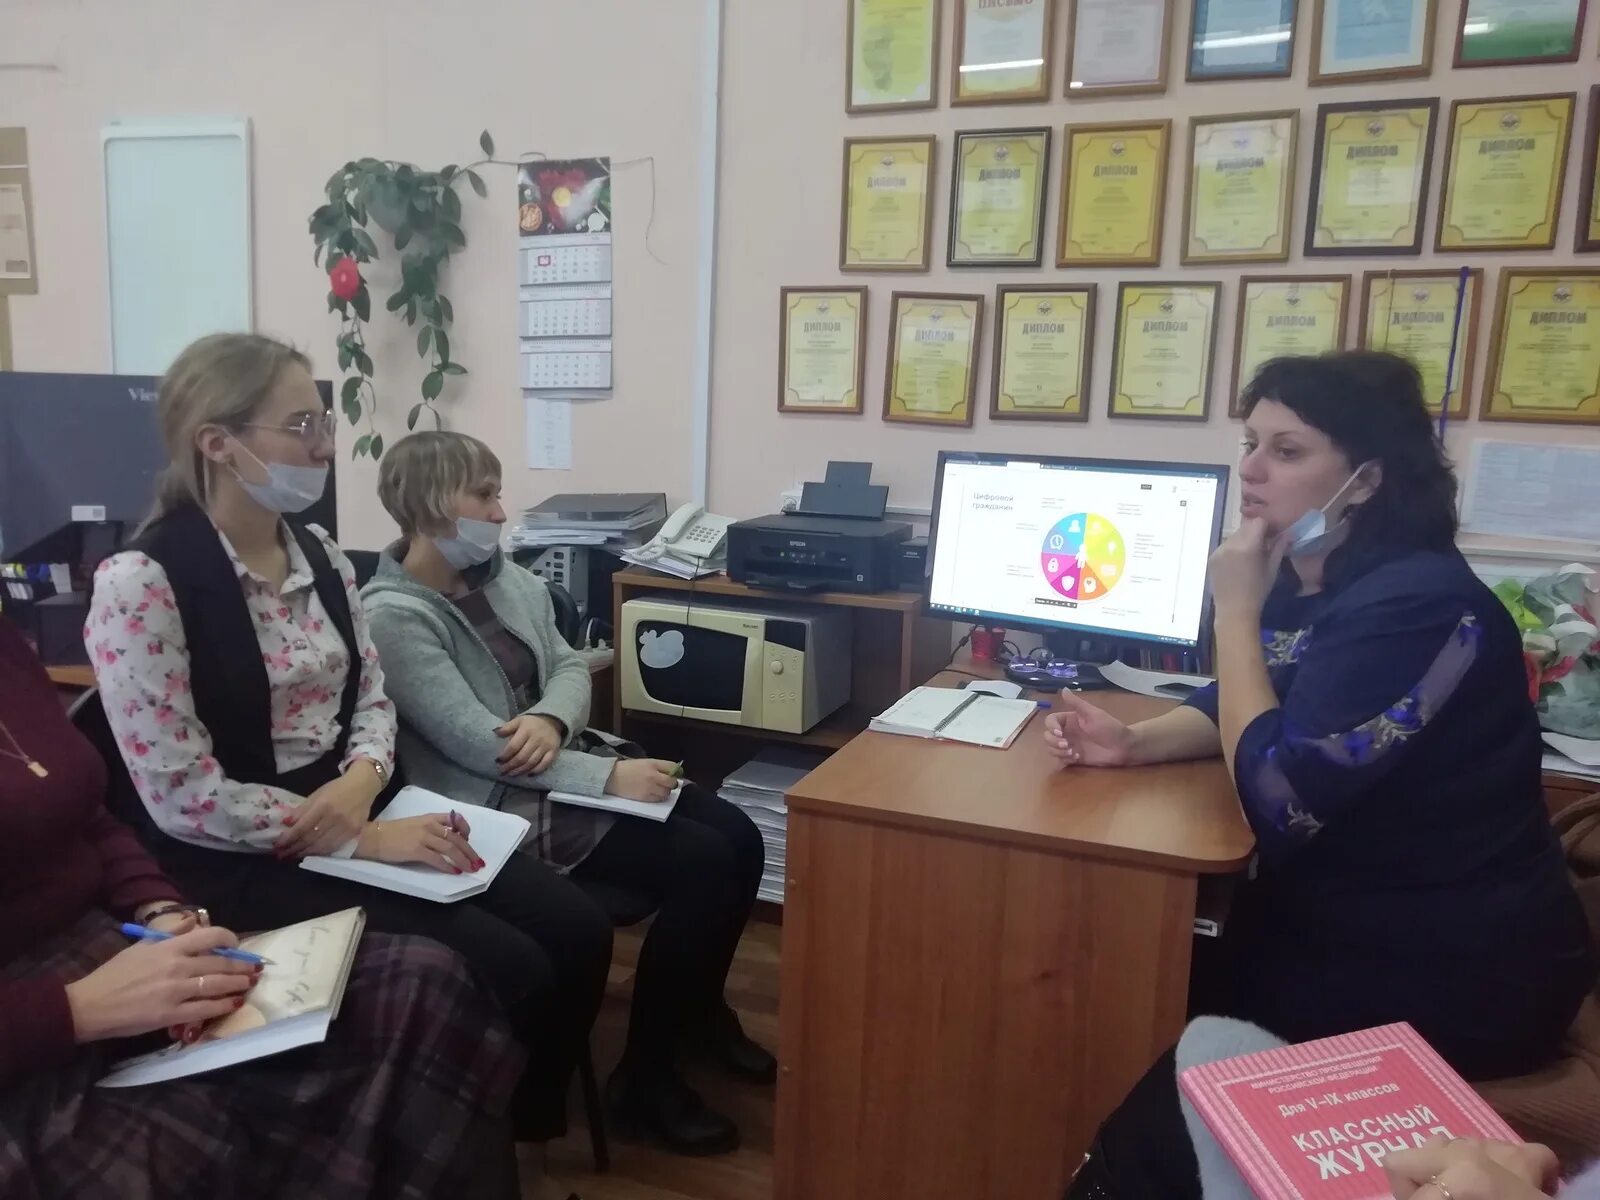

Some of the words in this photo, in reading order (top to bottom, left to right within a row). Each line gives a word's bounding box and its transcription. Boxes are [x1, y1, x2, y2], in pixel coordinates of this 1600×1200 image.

[803, 321, 841, 333] ДИПЛОМ
[1022, 322, 1065, 335] ДИПЛОМ
[1142, 320, 1188, 333] ДИПЛОМ
[1278, 1103, 1306, 1119] Для
[1344, 1082, 1400, 1102] классов
[1291, 1103, 1440, 1152] КЛАССНЫЙ
